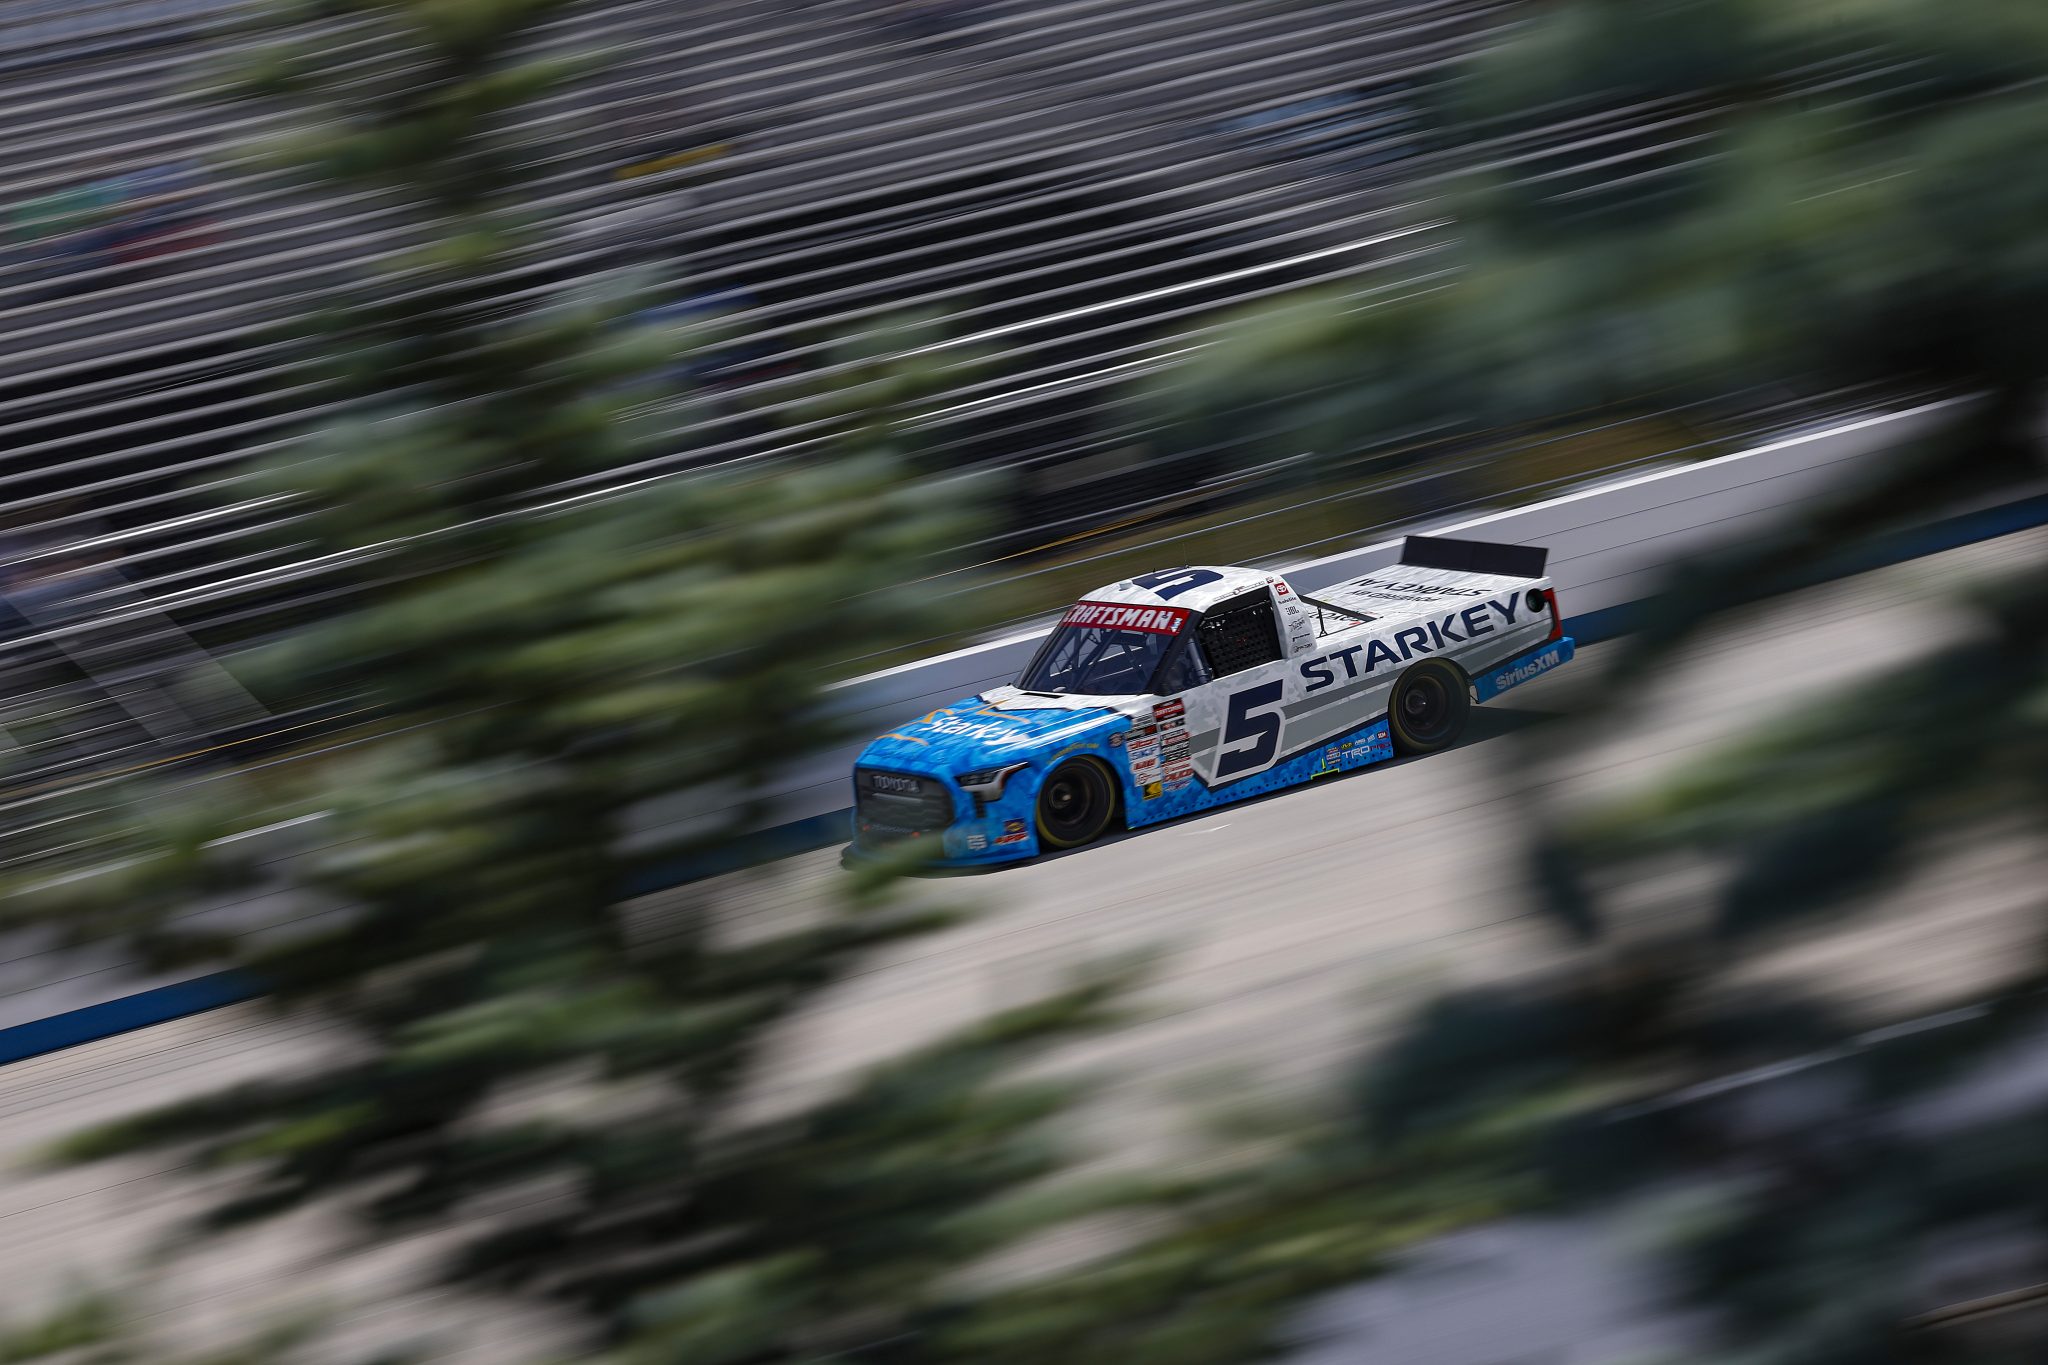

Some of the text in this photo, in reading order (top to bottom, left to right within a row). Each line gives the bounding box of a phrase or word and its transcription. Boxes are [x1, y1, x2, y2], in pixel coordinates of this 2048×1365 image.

[1132, 566, 1224, 601] 5
[1063, 604, 1173, 630] CRAFTSMAN
[1300, 592, 1519, 692] STARKEY
[1496, 650, 1560, 690] SiriusXM
[916, 716, 1030, 746] Starkey
[1215, 679, 1284, 778] 5
[873, 775, 920, 793] TOYOTA
